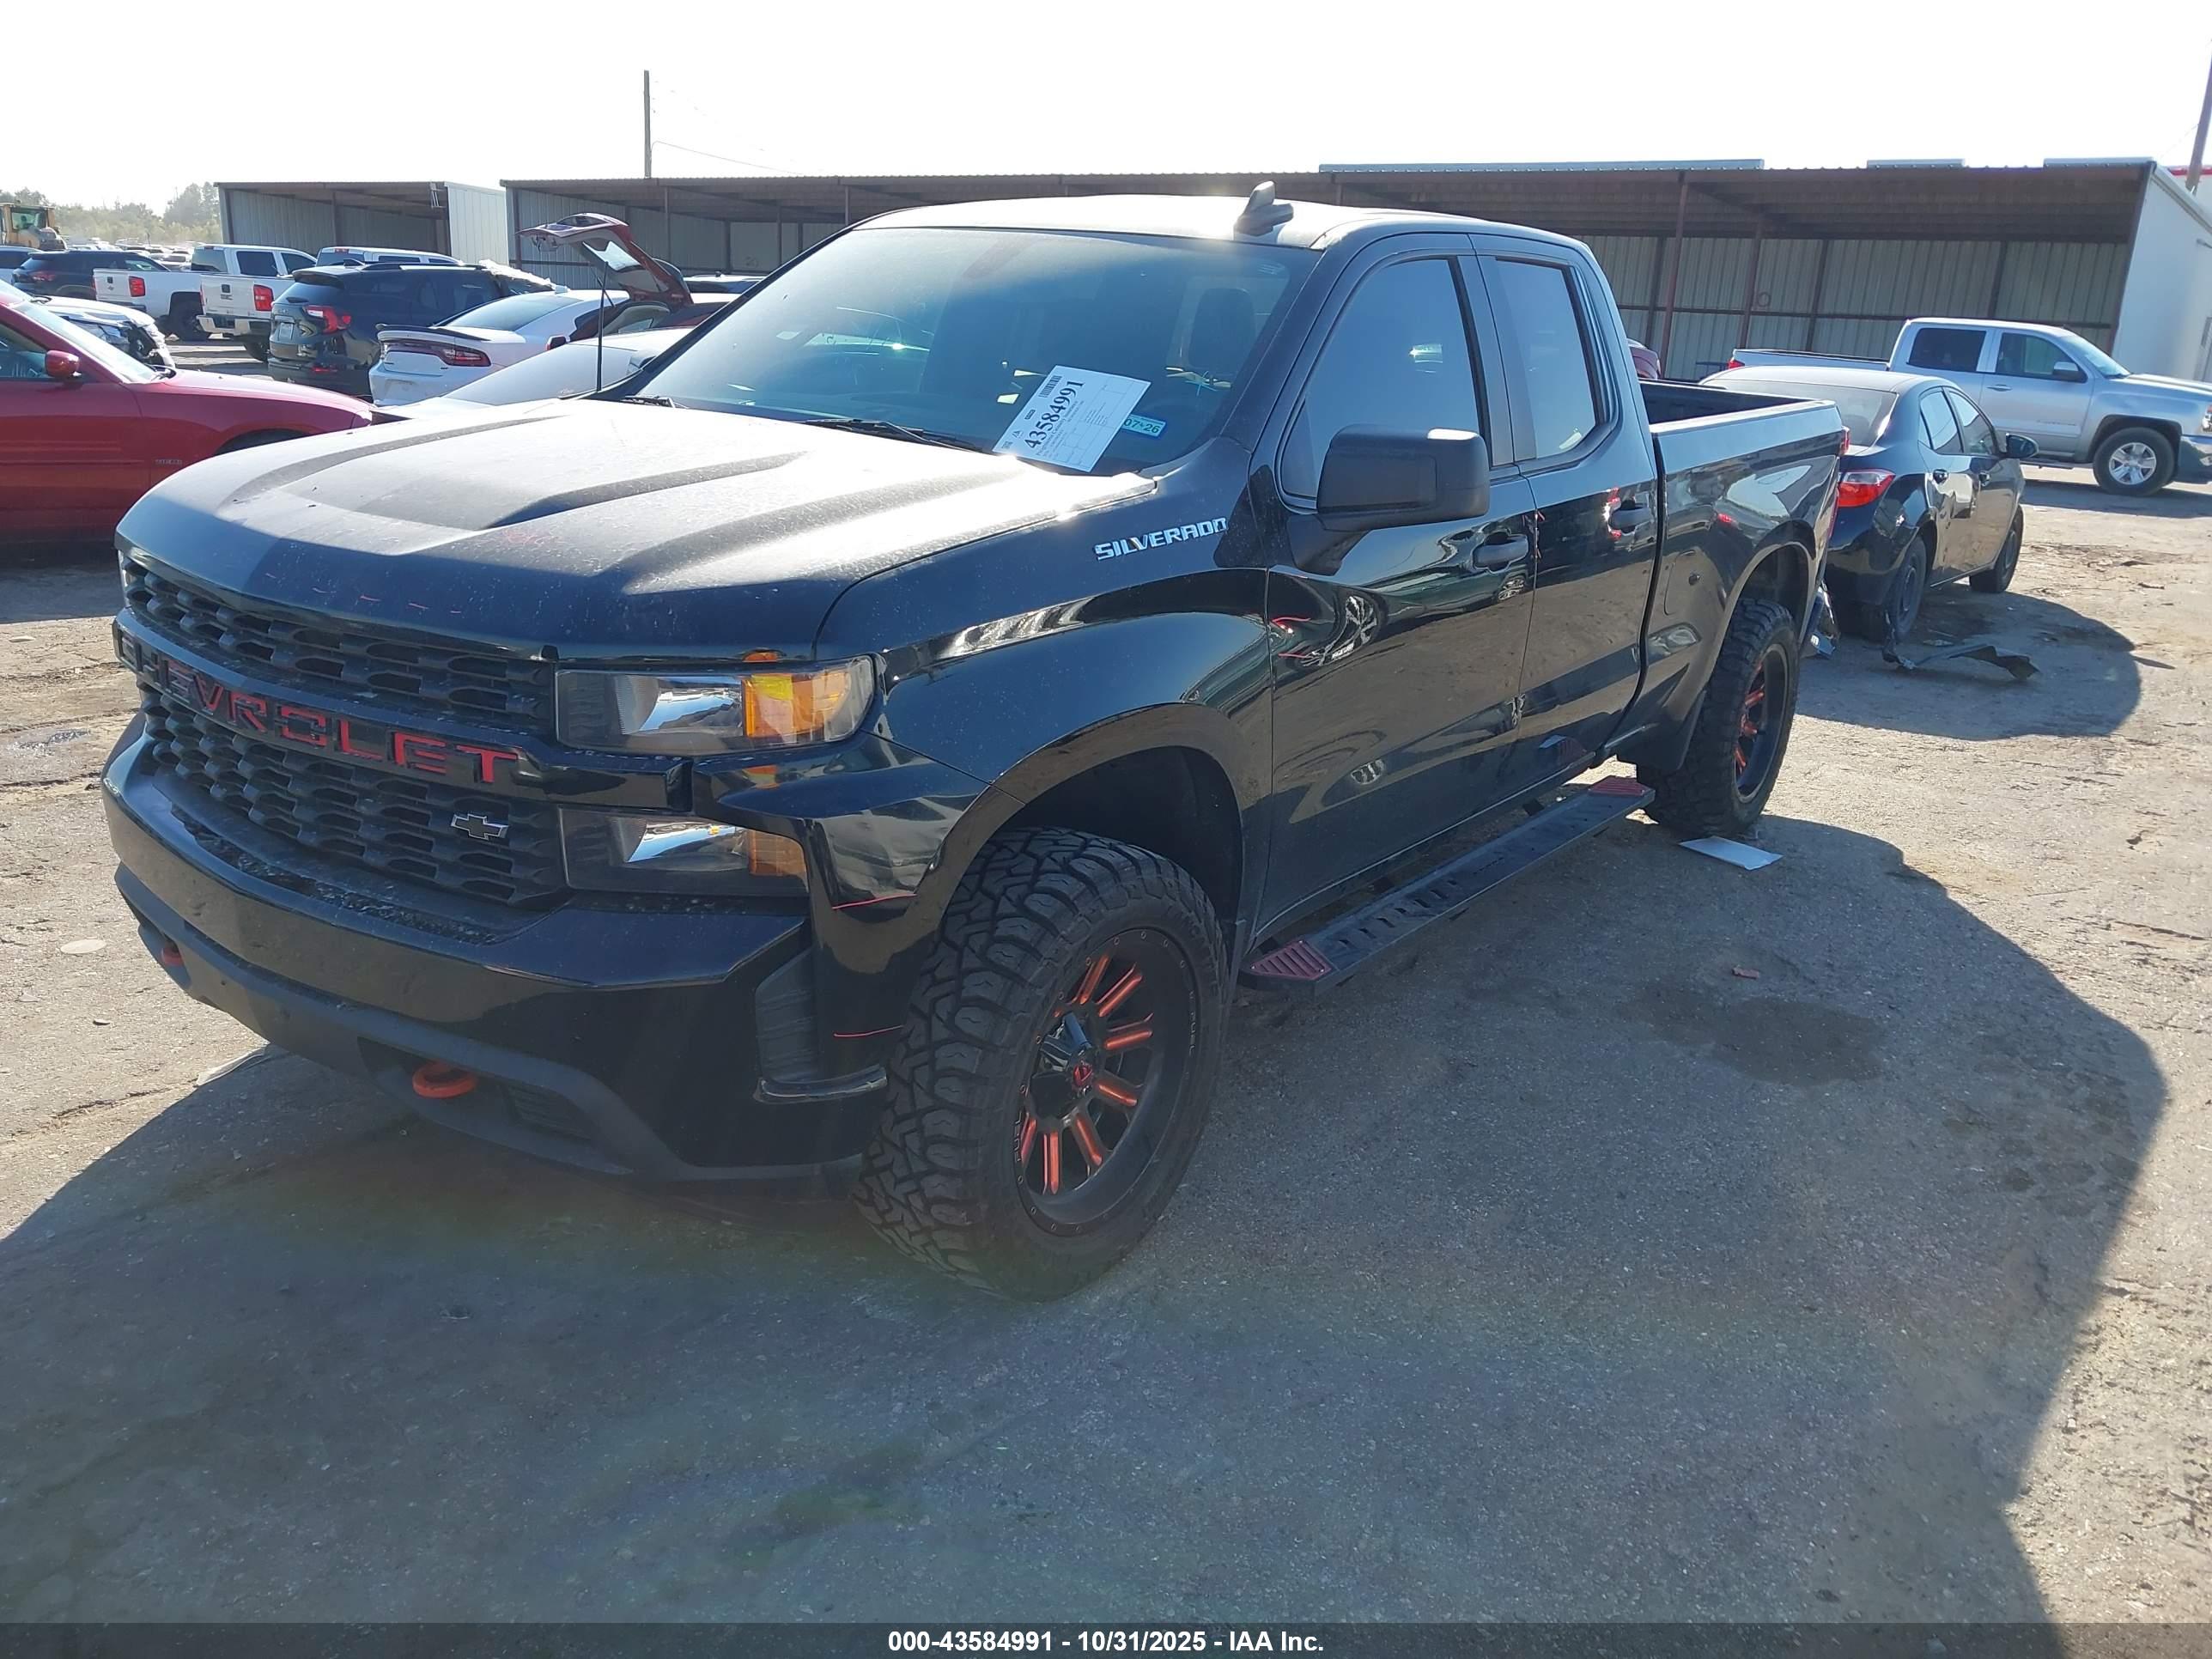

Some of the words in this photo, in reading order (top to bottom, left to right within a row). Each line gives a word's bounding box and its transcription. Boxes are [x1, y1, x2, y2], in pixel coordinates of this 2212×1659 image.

[1024, 380, 1085, 448] 43584991
[1143, 423, 1161, 434] 26
[1094, 517, 1227, 561] SILVERADO
